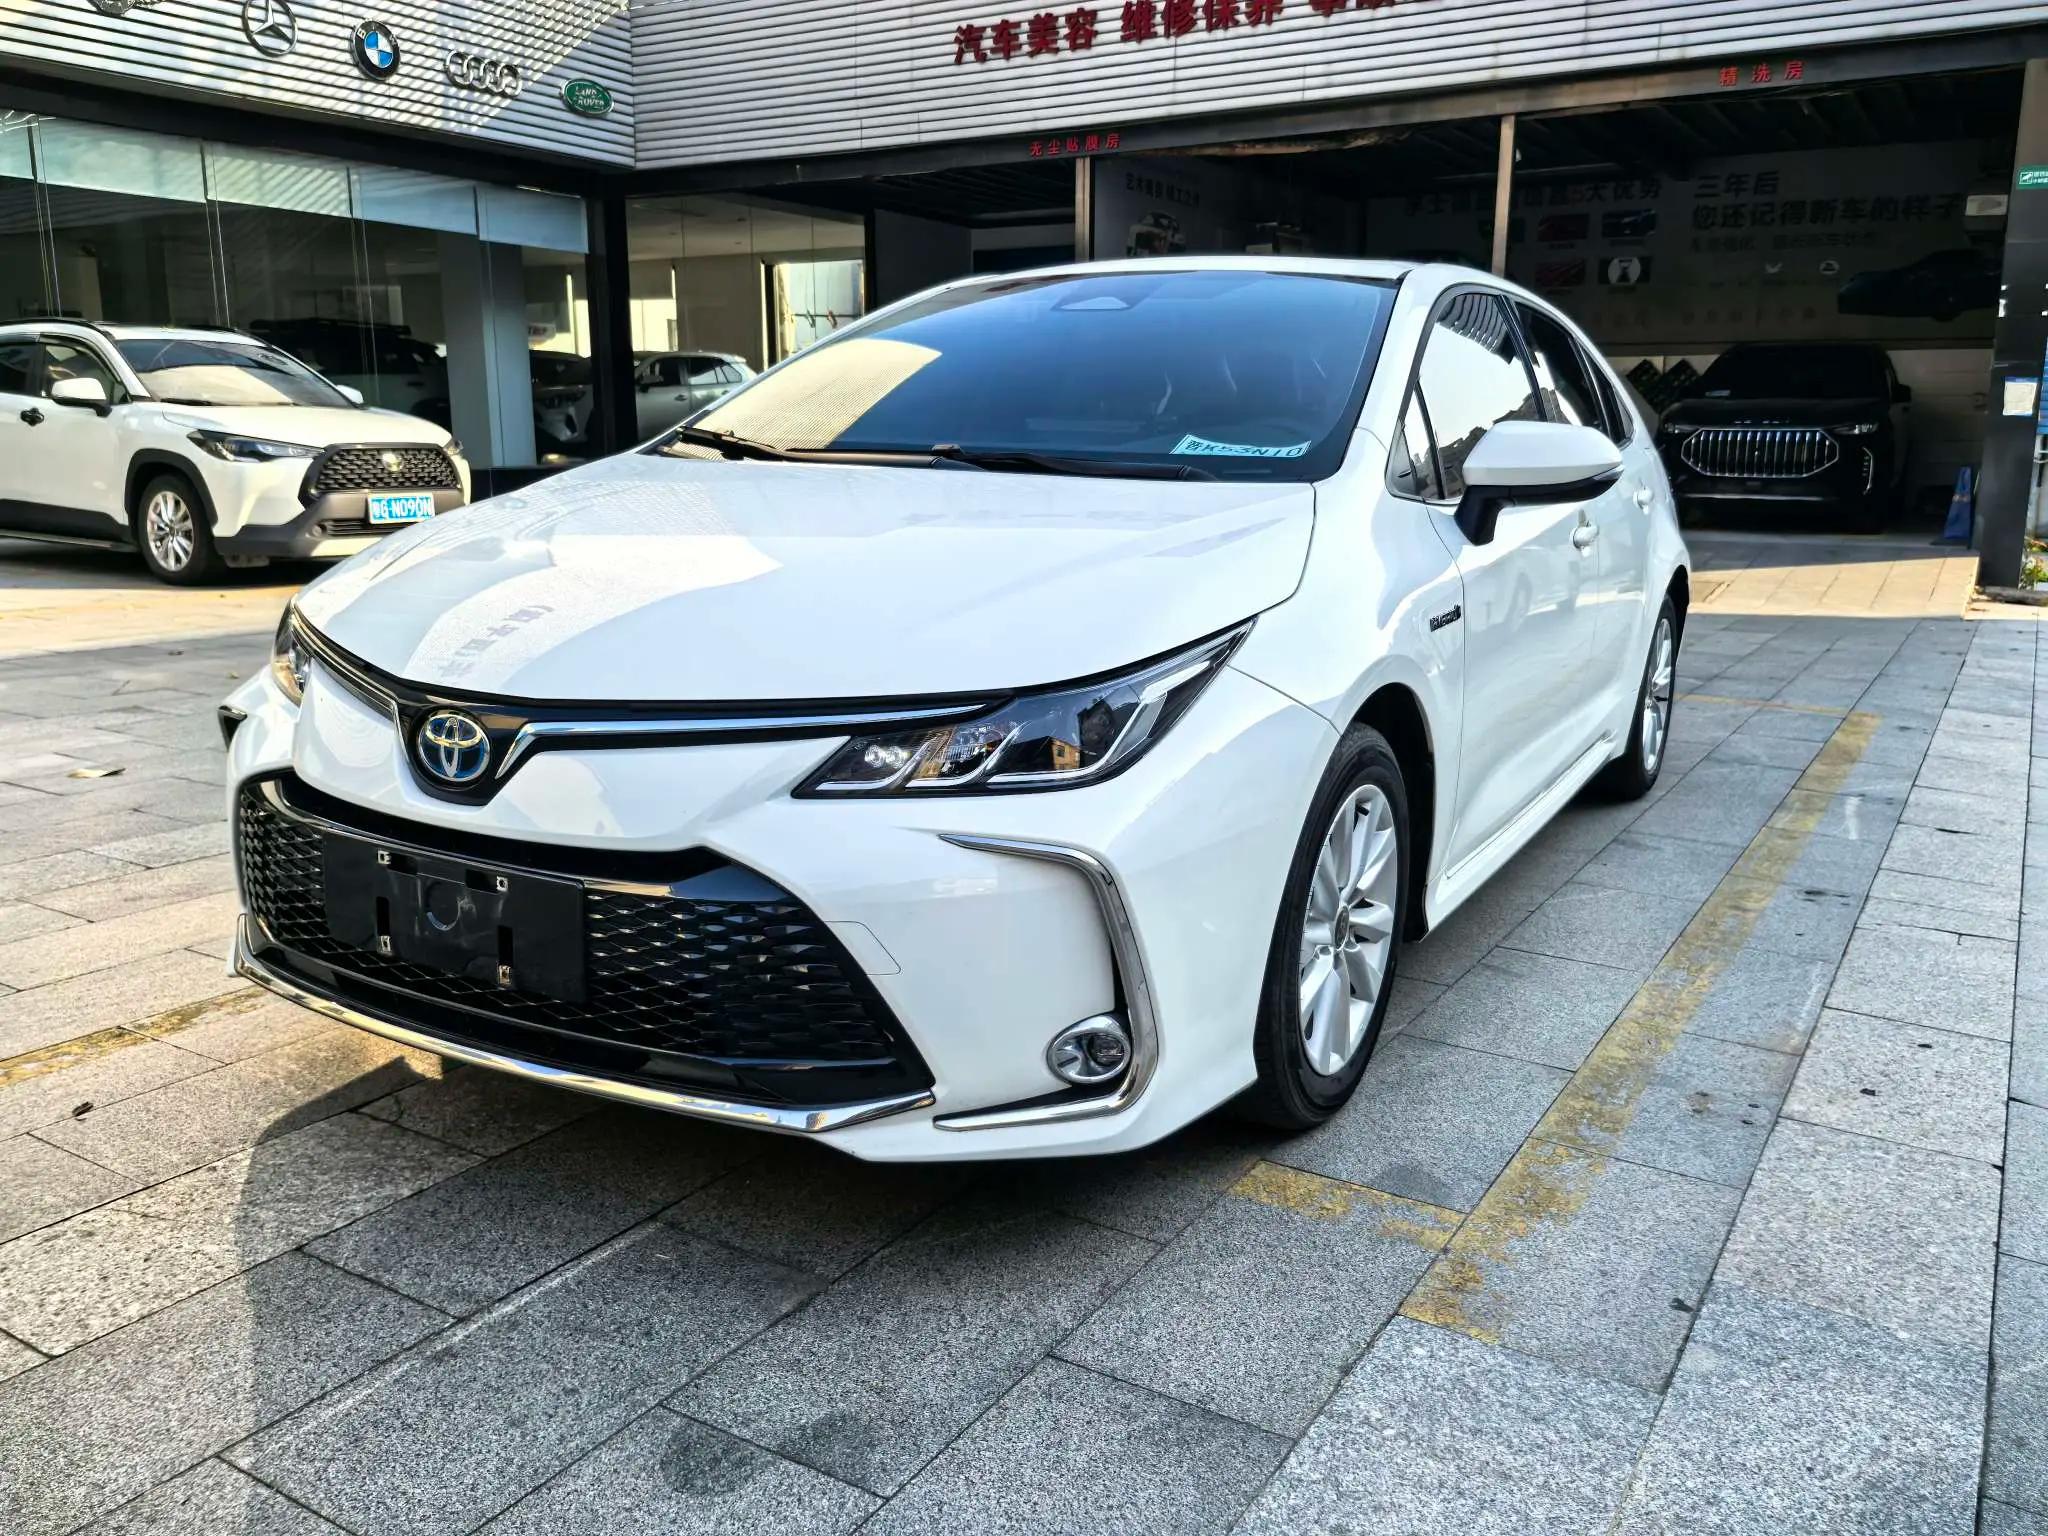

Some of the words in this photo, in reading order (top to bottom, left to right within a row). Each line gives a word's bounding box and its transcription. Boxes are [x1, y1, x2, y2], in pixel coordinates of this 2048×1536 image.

[954, 8, 1099, 64] 汽车美容
[1717, 60, 1805, 88] 精洗房
[575, 85, 598, 97] LAND
[577, 97, 605, 107] ROVER
[1693, 170, 1780, 199] 三年后
[1692, 193, 1966, 231] 您还记得新车的样子
